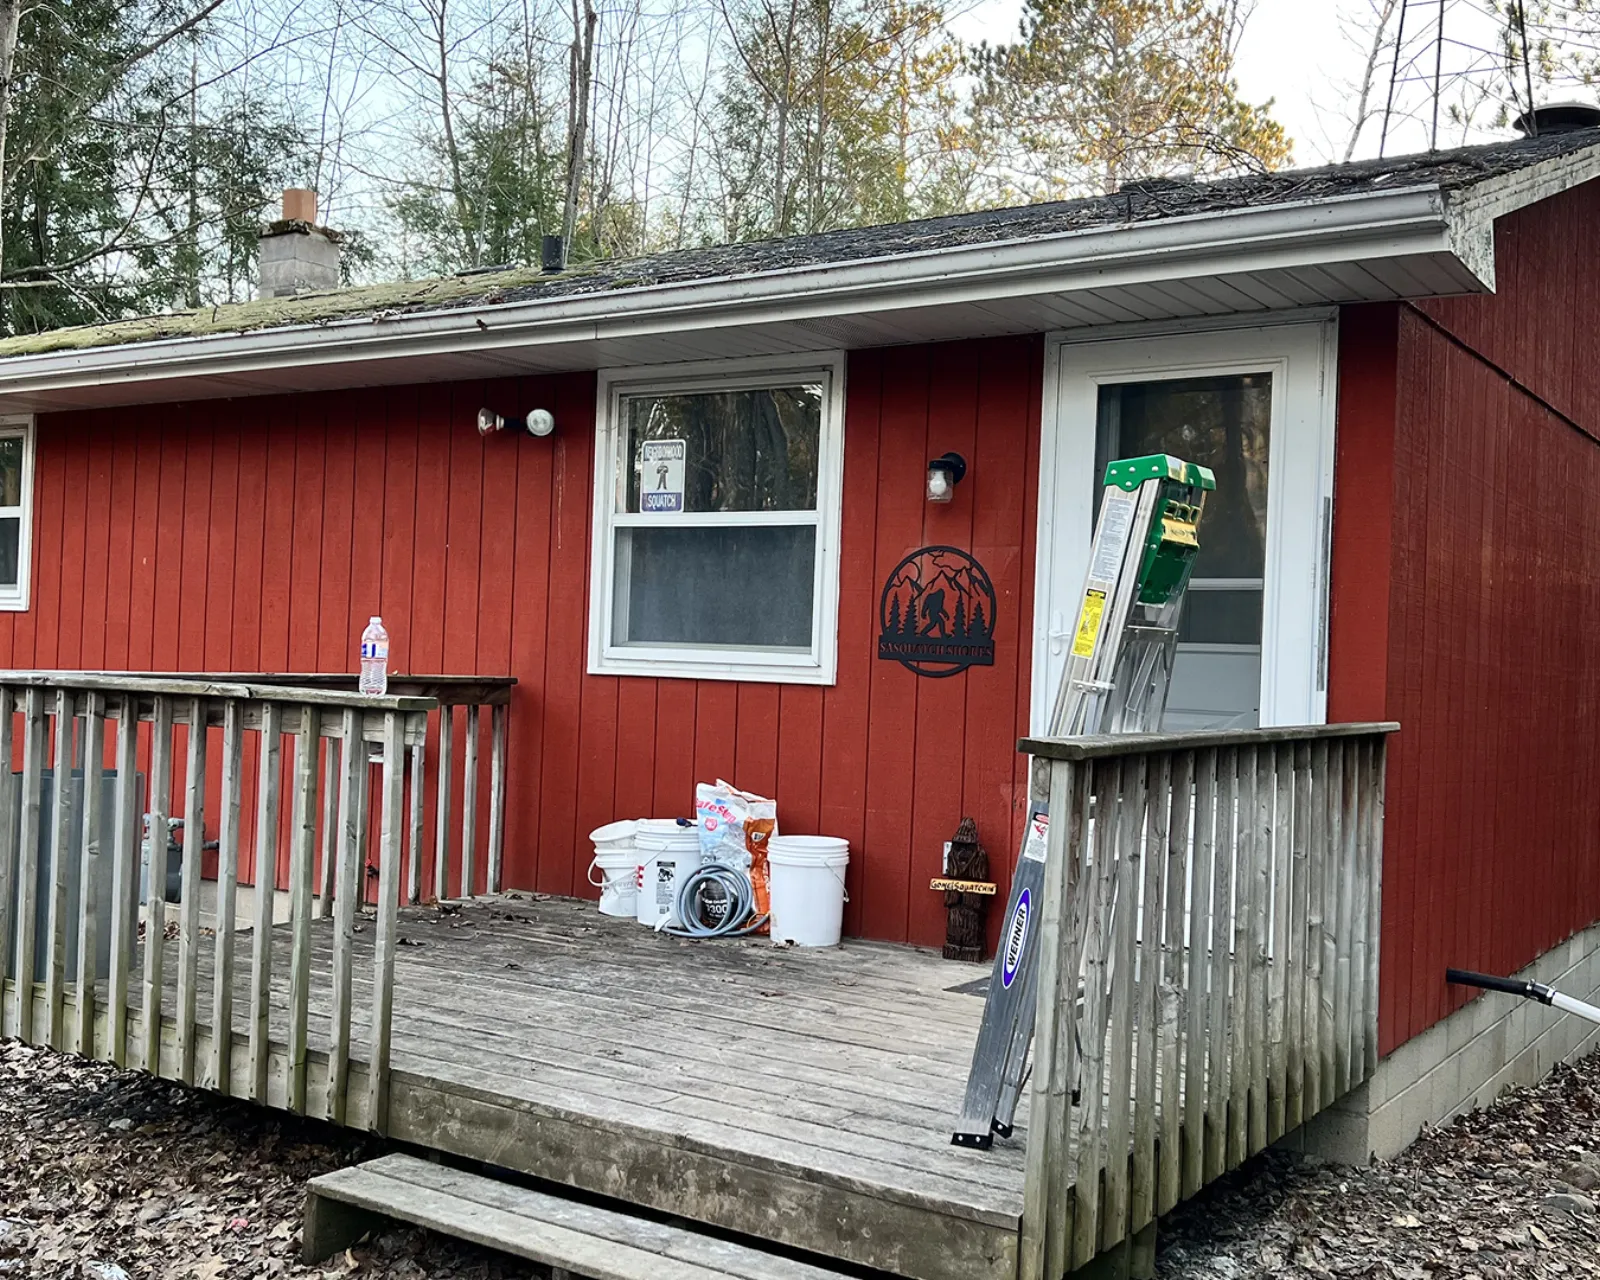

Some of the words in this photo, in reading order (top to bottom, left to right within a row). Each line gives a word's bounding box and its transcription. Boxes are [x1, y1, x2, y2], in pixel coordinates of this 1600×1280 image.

[648, 494, 677, 509] SQUATCH
[880, 643, 944, 656] SASQUATCH
[947, 645, 992, 658] SHORES
[1007, 908, 1026, 967] WERNER
